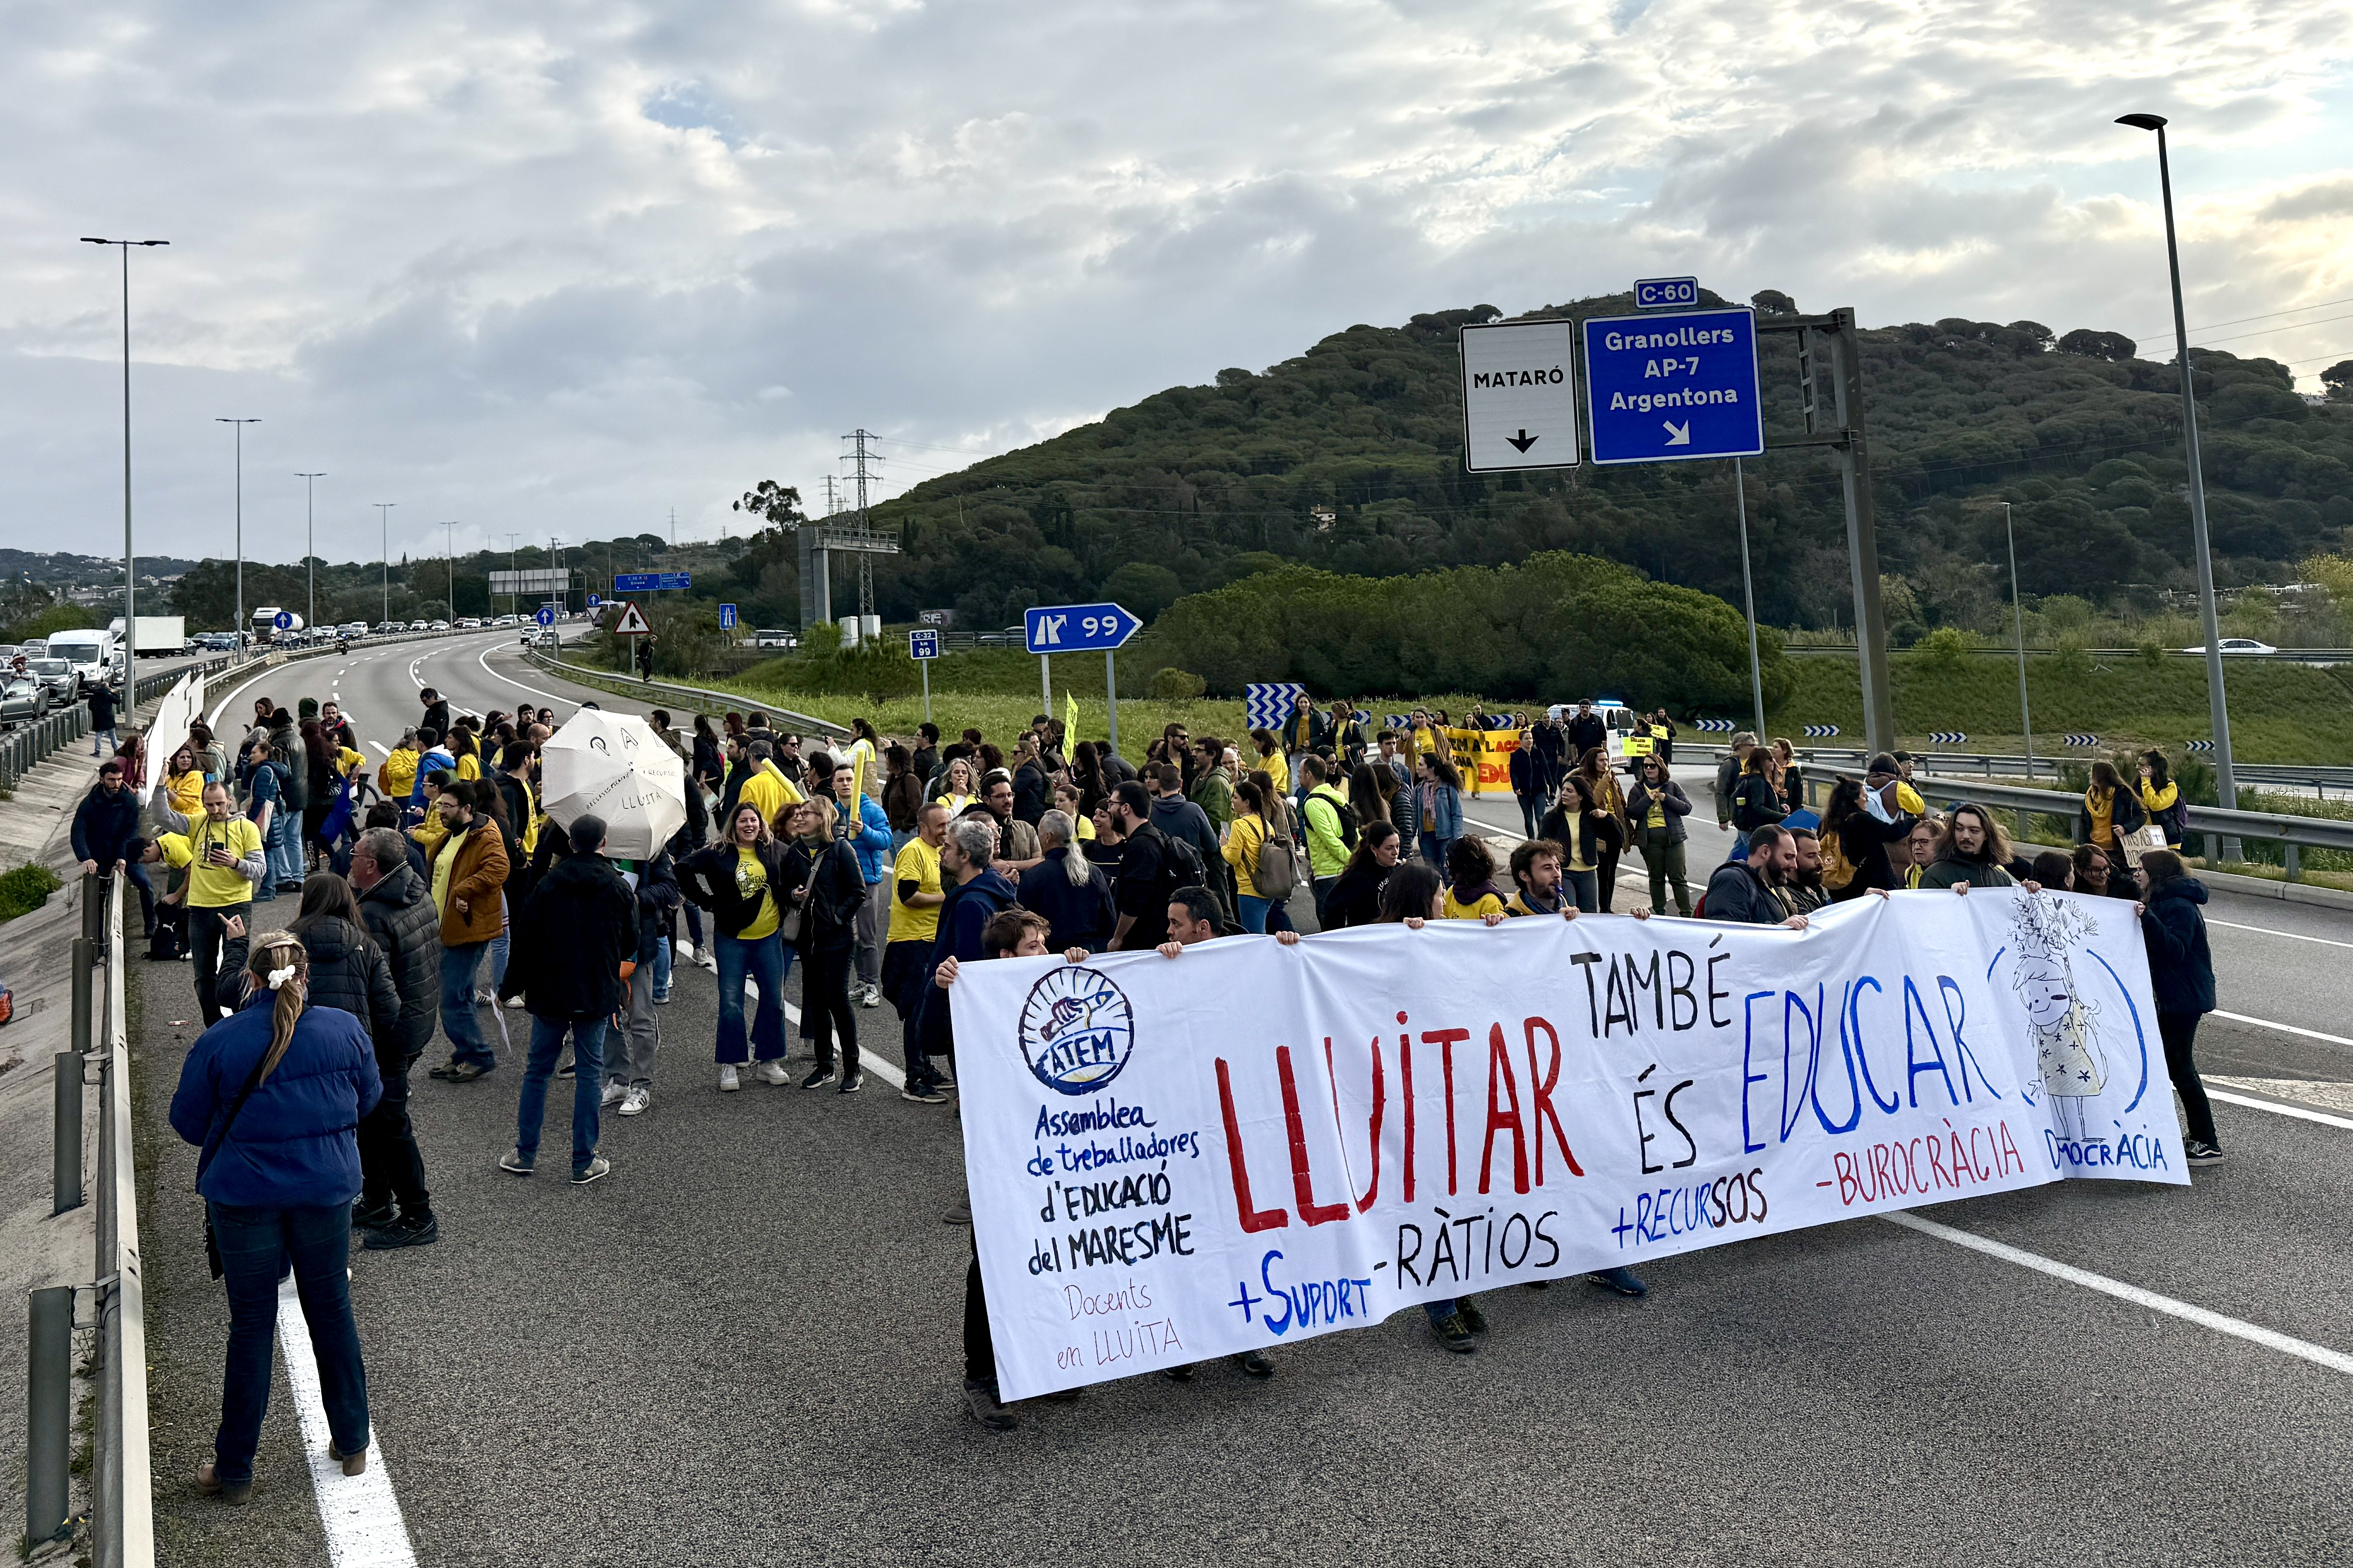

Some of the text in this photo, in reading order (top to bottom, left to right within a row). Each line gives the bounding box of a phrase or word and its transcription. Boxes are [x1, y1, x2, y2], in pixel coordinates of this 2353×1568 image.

[1641, 284, 1692, 301] C-60
[1605, 327, 1734, 351] Granollers
[1473, 364, 1564, 389] MATARÓ
[1644, 356, 1699, 379] AP-7
[1610, 388, 1738, 413] Argentona
[1081, 615, 1118, 638] 99
[919, 648, 931, 656] 99
[1477, 763, 1511, 783] EDU
[622, 791, 662, 809] LLUITA
[1570, 933, 1732, 1039] TAMBÉ
[1051, 1030, 1116, 1074] ATEM
[1742, 975, 2002, 1155] EDUCAR
[1035, 1097, 1158, 1140] Assemblea
[1634, 1063, 1697, 1175] ÉS
[1027, 1131, 1200, 1176] de treballadores
[1040, 1160, 1171, 1223] d'EDUCACIÓ
[1611, 1167, 1769, 1249] +RECURSOS
[1028, 1212, 1195, 1276] del MARESME
[1064, 1278, 1153, 1321] Docents
[1057, 1346, 1084, 1370] en
